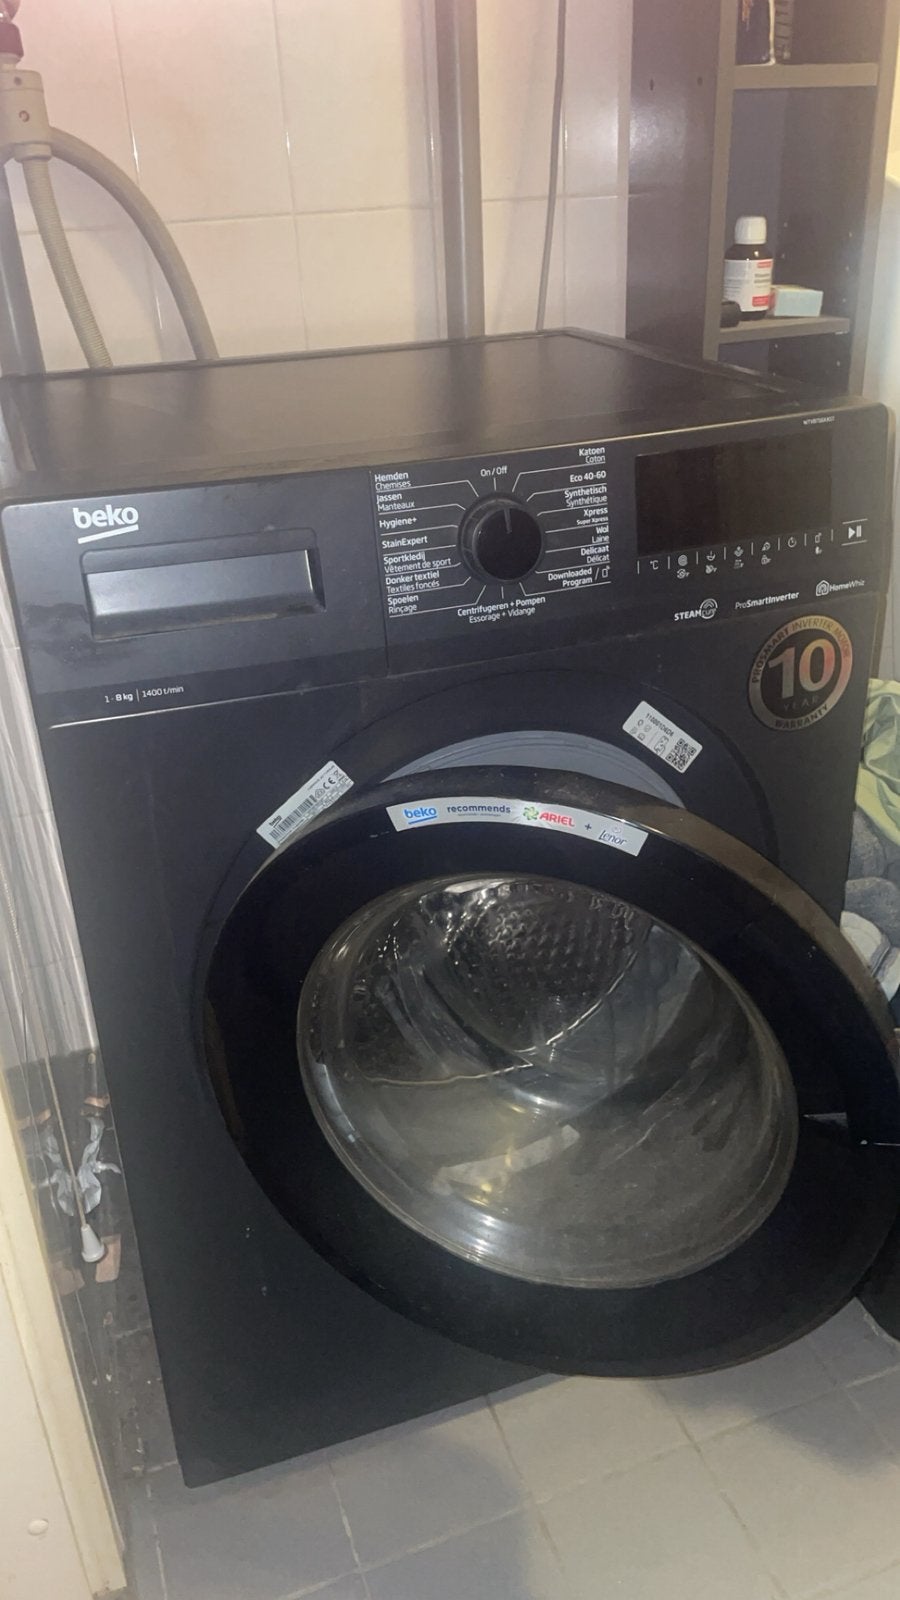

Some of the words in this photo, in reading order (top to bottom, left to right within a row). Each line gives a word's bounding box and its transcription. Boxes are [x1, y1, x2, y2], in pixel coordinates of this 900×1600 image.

[579, 447, 605, 456] Katoen
[585, 455, 606, 464] Coton
[374, 472, 409, 482] Hemden
[570, 474, 583, 483] Eco
[584, 470, 607, 480] 40-60
[375, 480, 411, 491] Chemises
[564, 485, 607, 499] Synthetisch
[376, 493, 402, 504] Jassen
[566, 495, 608, 508] Synthétique
[378, 501, 415, 511] Manteaux
[73, 504, 138, 530] beko
[584, 507, 608, 519] Xpress
[379, 517, 417, 529] Hygiene+
[596, 525, 609, 534] Wol
[382, 535, 428, 549] StainExpert
[592, 535, 609, 544] Laine
[581, 545, 609, 556] Delicaat
[383, 551, 426, 565] Sportkledij
[586, 554, 610, 563] Délicat
[384, 562, 421, 573] Vêtement
[422, 560, 431, 569] de
[432, 558, 451, 569] sport
[385, 574, 413, 585] Donker
[414, 571, 440, 581] textiel
[548, 567, 592, 581] Downloaded
[387, 583, 415, 594] Textiles
[415, 580, 440, 590] foncés
[562, 577, 593, 587] Program
[387, 595, 419, 606] Spoelen
[457, 602, 509, 617] Centrifugeren
[515, 596, 546, 608] Pompen
[735, 592, 799, 609] ProSmartInverter
[388, 604, 418, 614] Rinçage
[469, 612, 500, 624] Essorage
[507, 607, 536, 617] Vidange
[751, 628, 789, 684] PROSMART
[791, 618, 833, 632] INVERTER
[768, 638, 835, 699] 10
[142, 688, 162, 698] 1400
[163, 686, 184, 695] t/min
[404, 807, 437, 819] beko
[447, 805, 511, 814] recommends
[540, 812, 575, 827] ARIEL
[598, 830, 627, 846] Lenor
